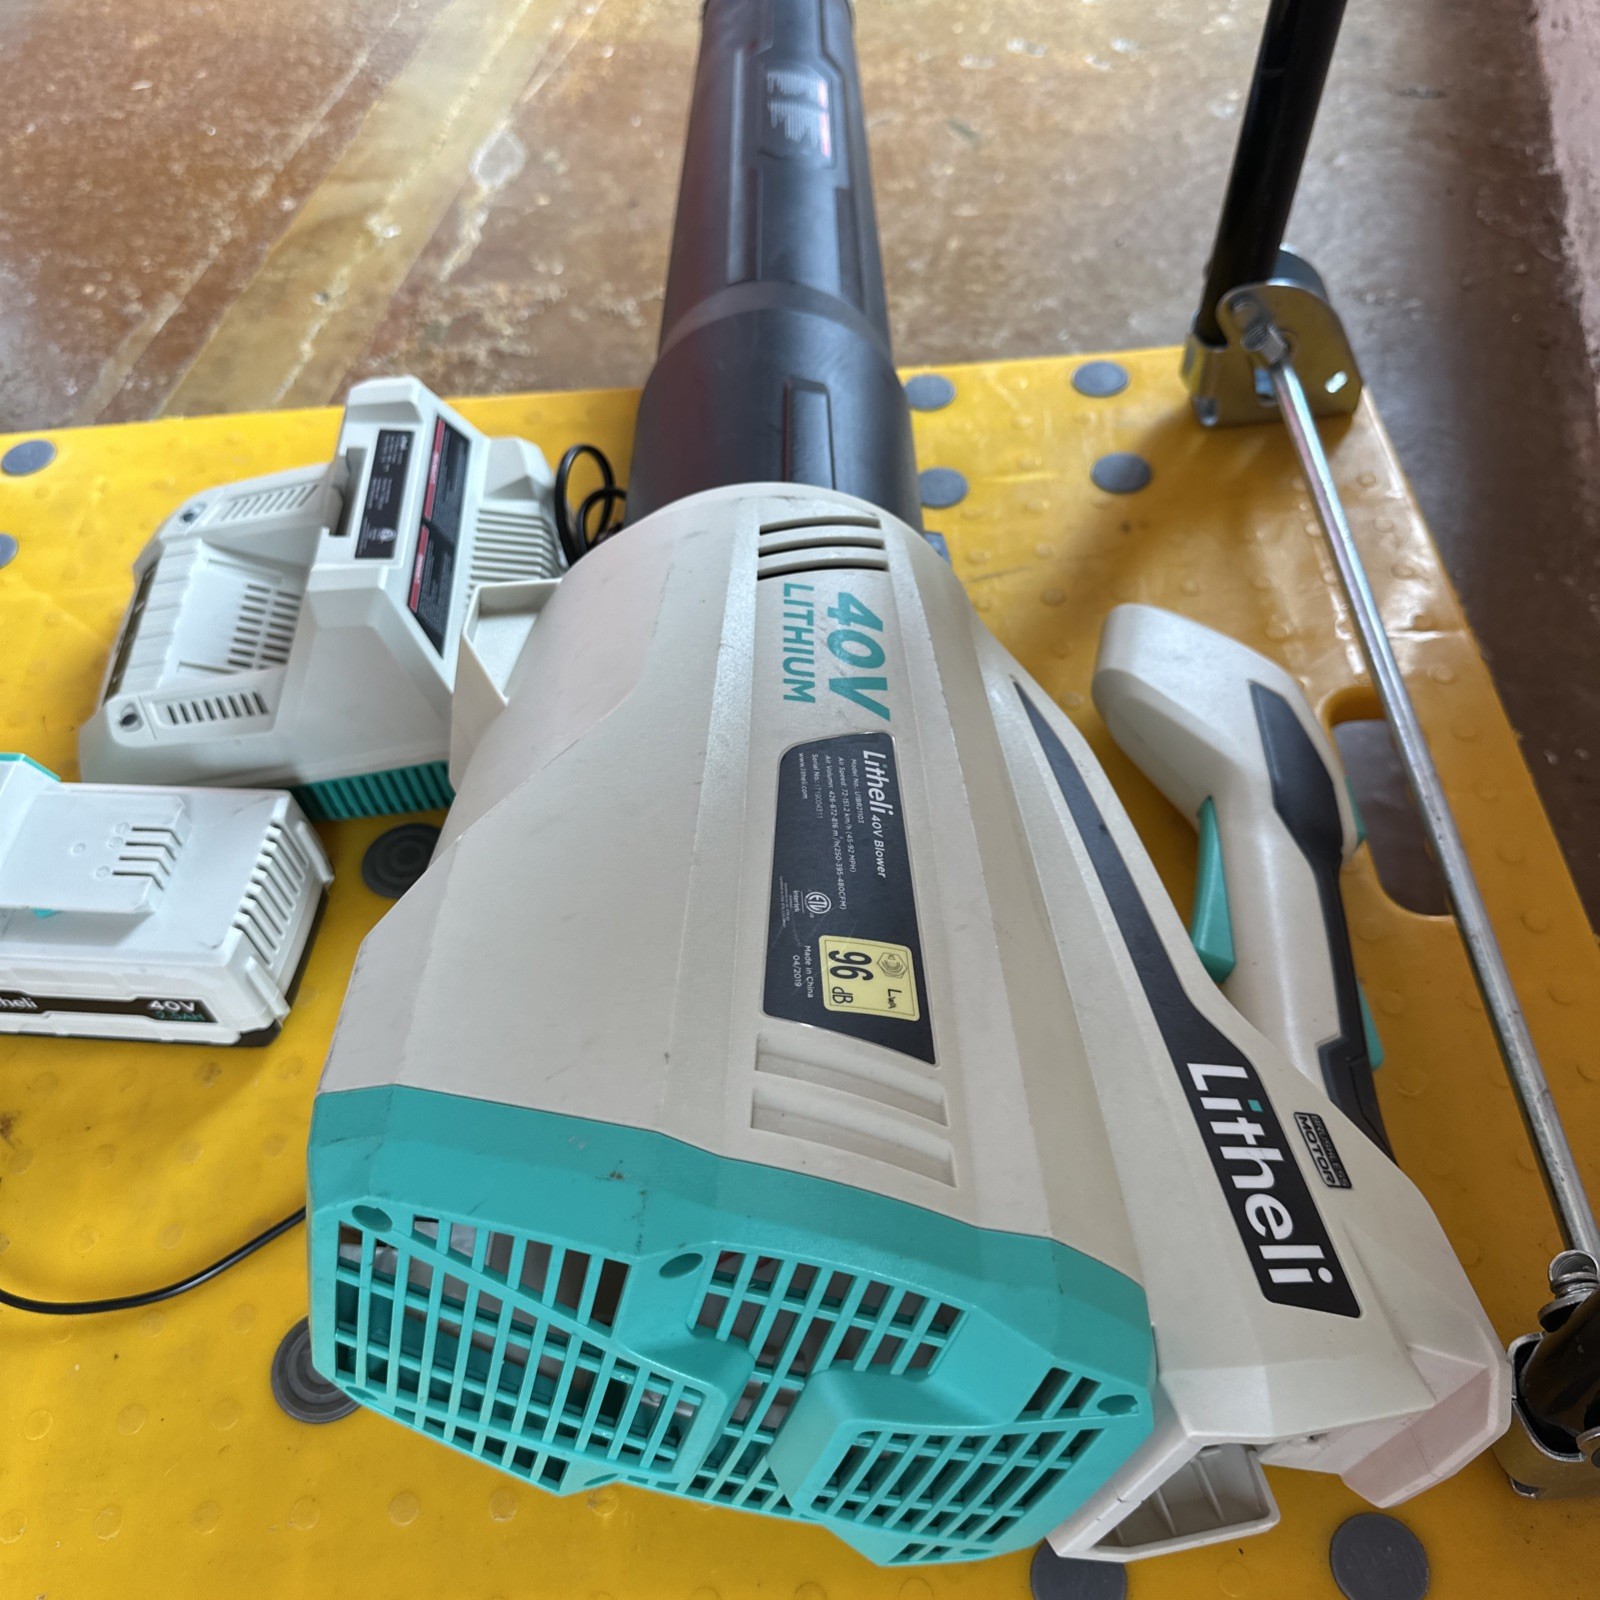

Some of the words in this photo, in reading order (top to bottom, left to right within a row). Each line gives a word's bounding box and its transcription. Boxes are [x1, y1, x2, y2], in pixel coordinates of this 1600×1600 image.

[782, 583, 816, 704] LITHIUM
[827, 592, 891, 722] 40V
[812, 754, 820, 770] Serial
[863, 750, 894, 816] Litheli
[828, 790, 838, 829] 426-672-816
[841, 813, 851, 830] km/h
[844, 831, 854, 854] (45-92
[871, 815, 883, 838] 40V
[873, 840, 887, 878] Blower
[793, 955, 802, 987] 04/2019
[806, 967, 813, 975] in
[828, 950, 874, 981] 96
[148, 1000, 195, 1012] 40V
[832, 986, 854, 1004] dB
[1298, 1116, 1335, 1184] MOTOR
[1312, 1116, 1348, 1186] BRUSHLESS
[1187, 1062, 1333, 1285] Litheli
